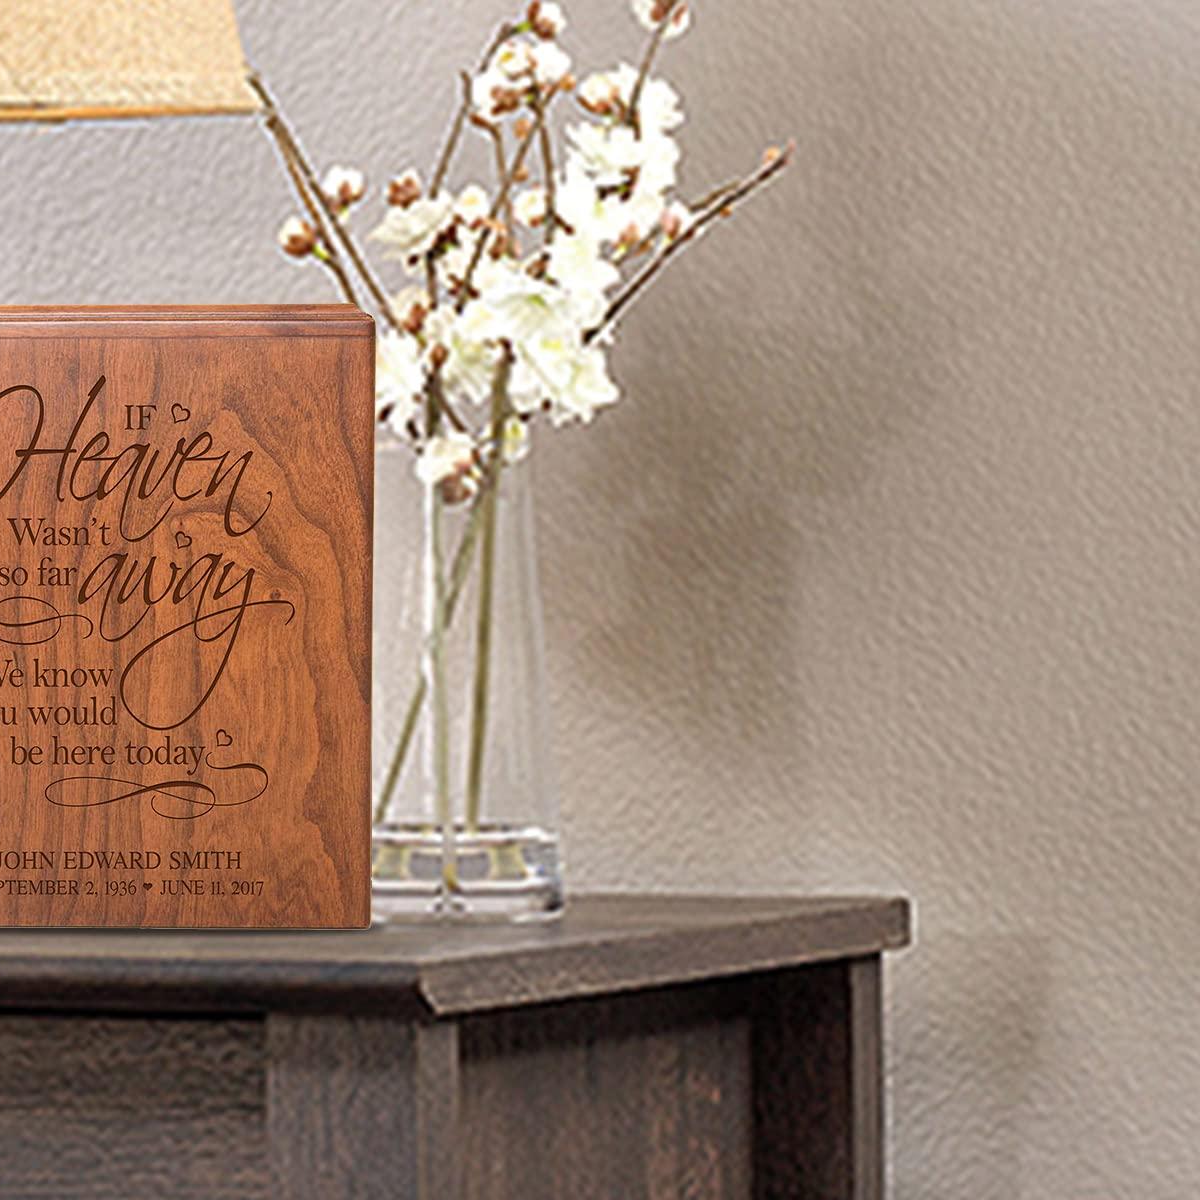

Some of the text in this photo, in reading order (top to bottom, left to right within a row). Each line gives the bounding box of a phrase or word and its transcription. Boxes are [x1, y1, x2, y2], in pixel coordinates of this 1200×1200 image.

[124, 403, 157, 431] IF
[6, 517, 112, 547] Wasn't
[37, 557, 79, 587] far
[33, 658, 114, 688] know
[27, 696, 118, 727] would
[10, 736, 207, 774] be here today
[63, 850, 162, 871] EDWARD
[168, 850, 243, 871] SMITH
[85, 879, 99, 898] 2,
[104, 879, 138, 897] 1936
[159, 879, 205, 897] JUNE
[211, 879, 226, 898] 11,
[231, 879, 265, 897] 2017
